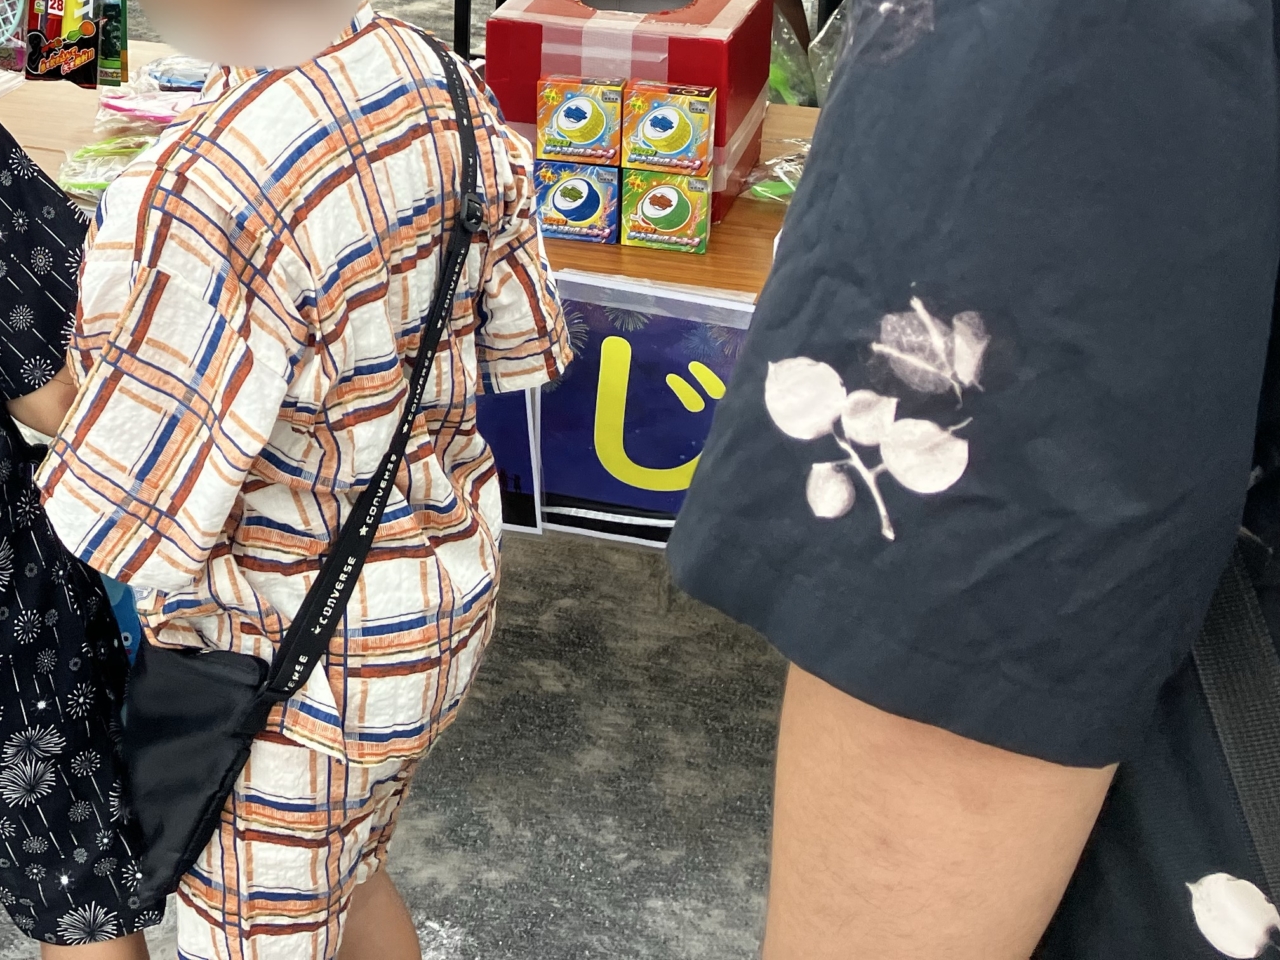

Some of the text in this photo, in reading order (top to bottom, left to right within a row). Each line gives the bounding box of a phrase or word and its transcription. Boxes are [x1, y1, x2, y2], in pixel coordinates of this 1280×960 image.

[593, 335, 727, 492] じ
[365, 453, 397, 525] CONVERSE
[319, 555, 357, 625] CONVERSE
